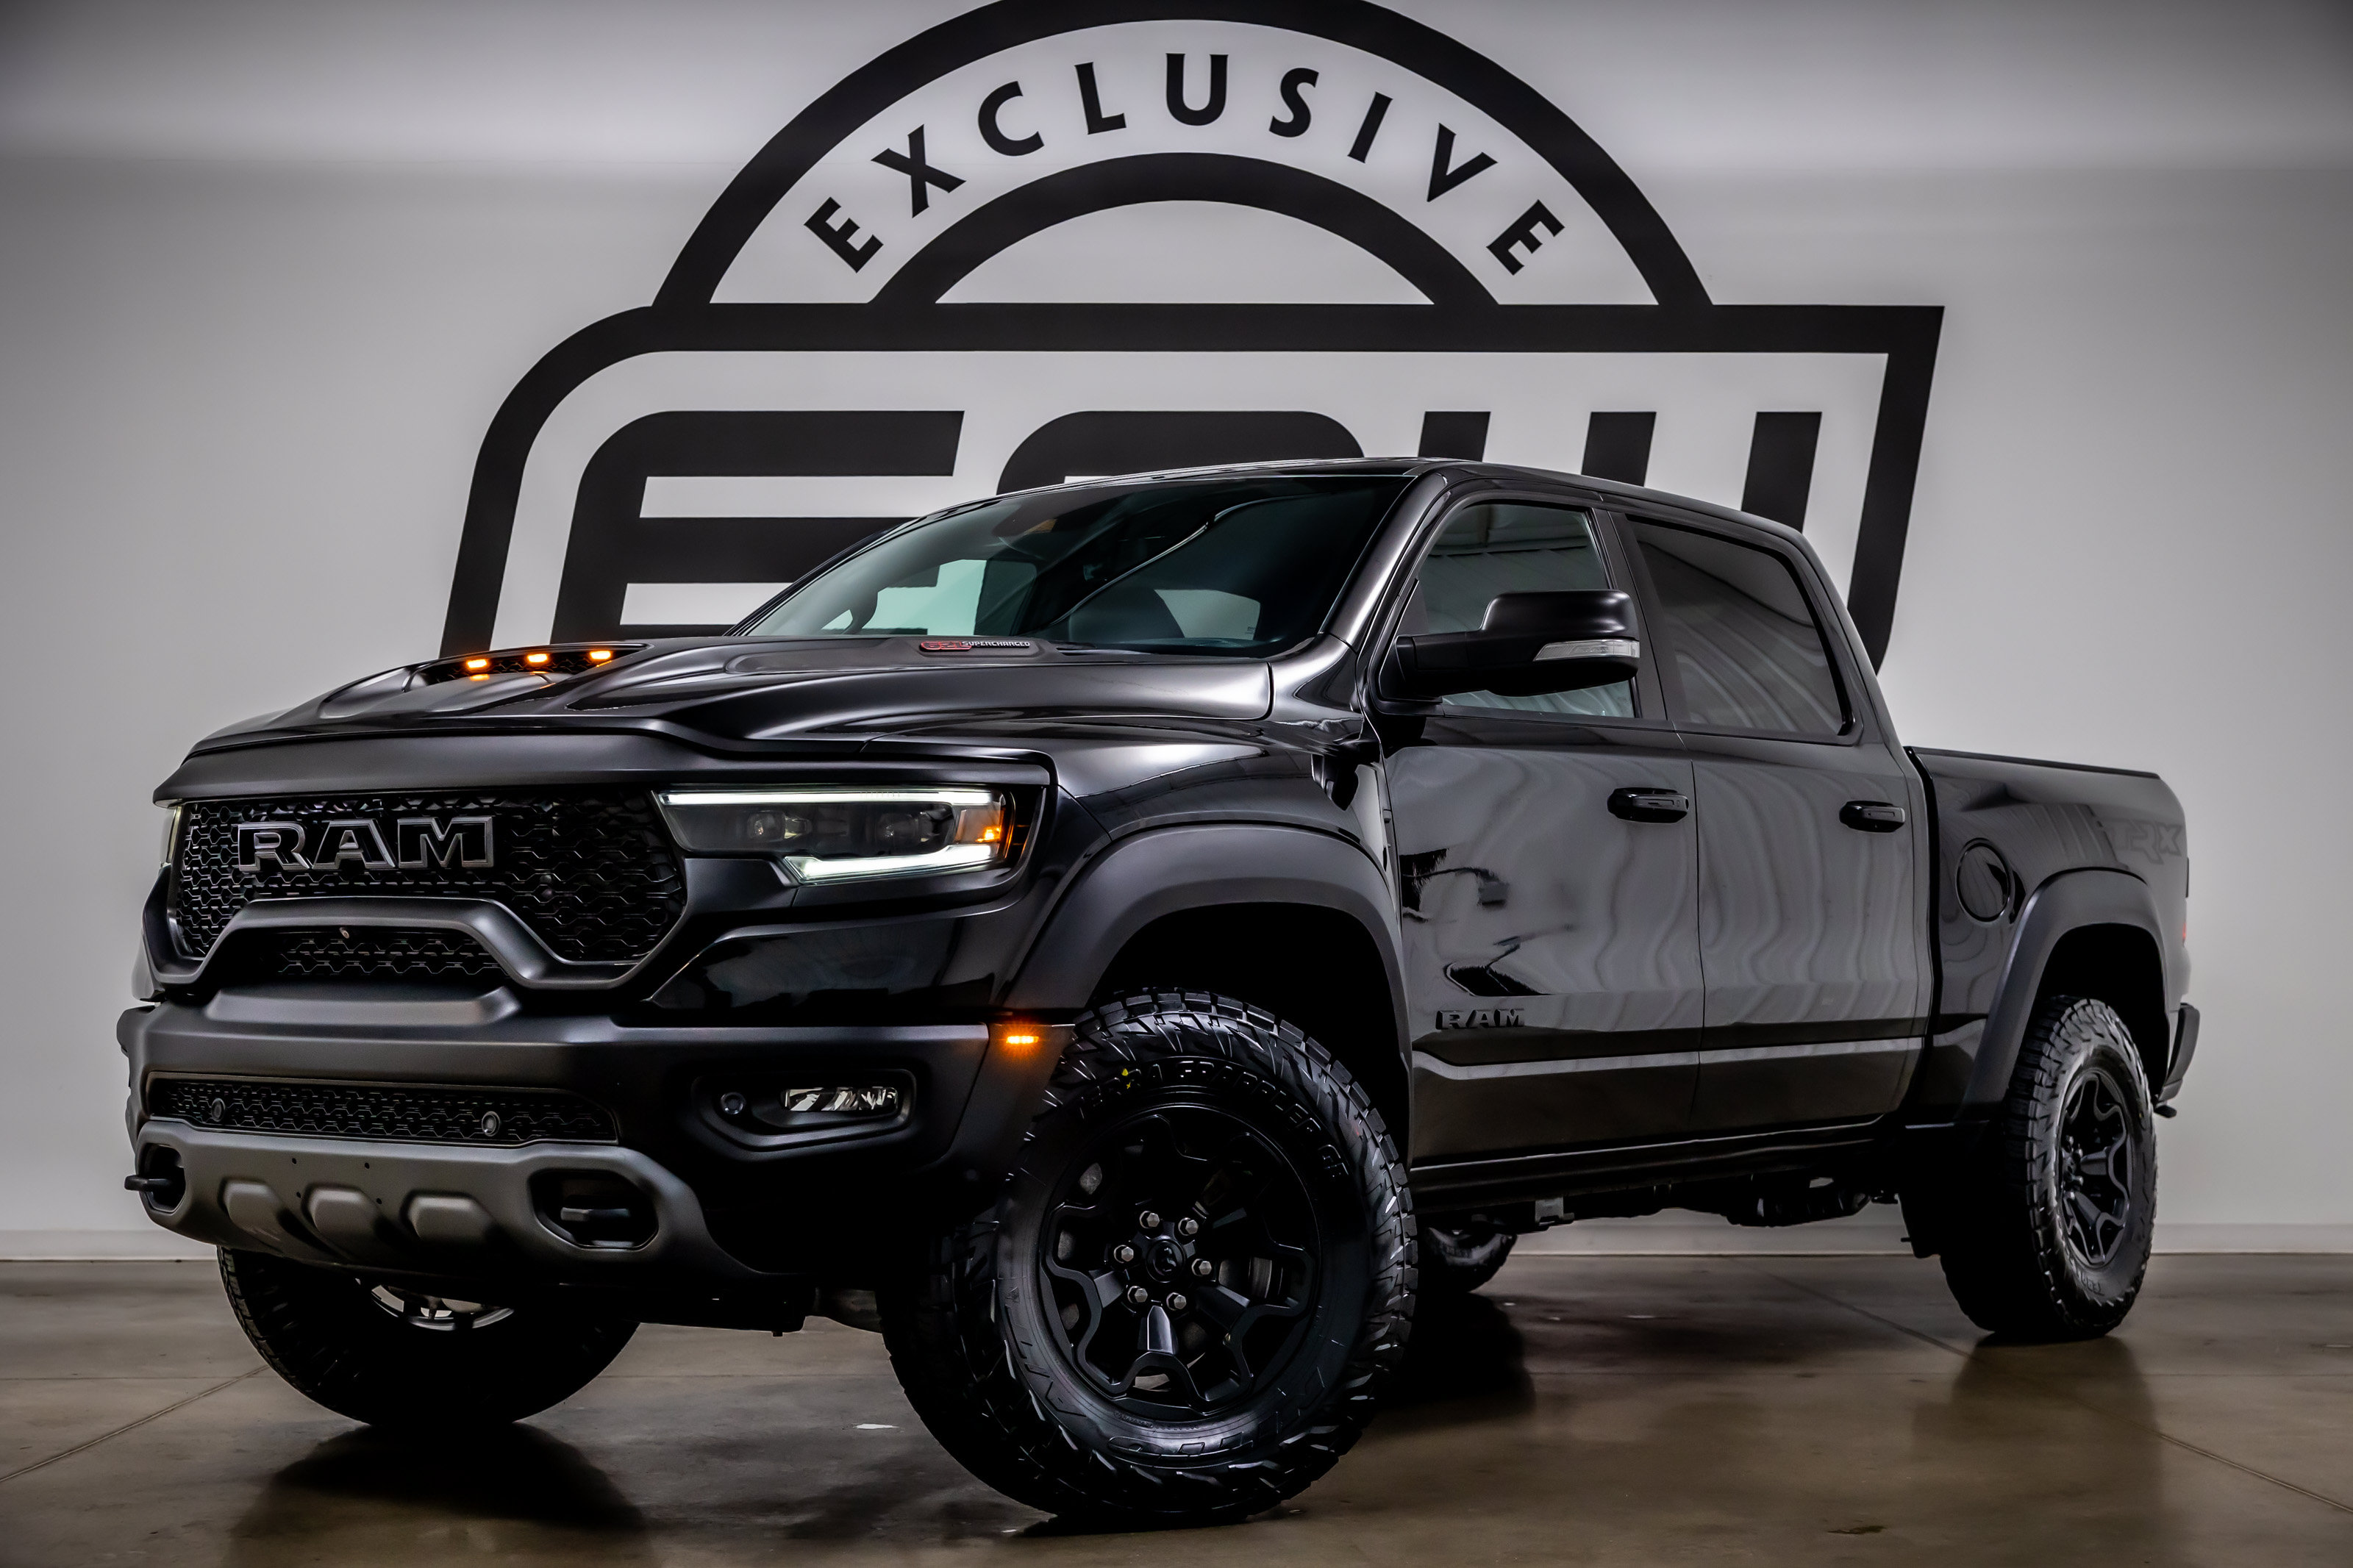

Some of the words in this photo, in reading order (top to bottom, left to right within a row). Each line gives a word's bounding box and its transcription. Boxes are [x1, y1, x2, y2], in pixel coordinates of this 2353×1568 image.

[803, 52, 1565, 275] EXCLUSIVE
[238, 817, 494, 872] RAM
[1435, 1008, 1524, 1029] RAM
